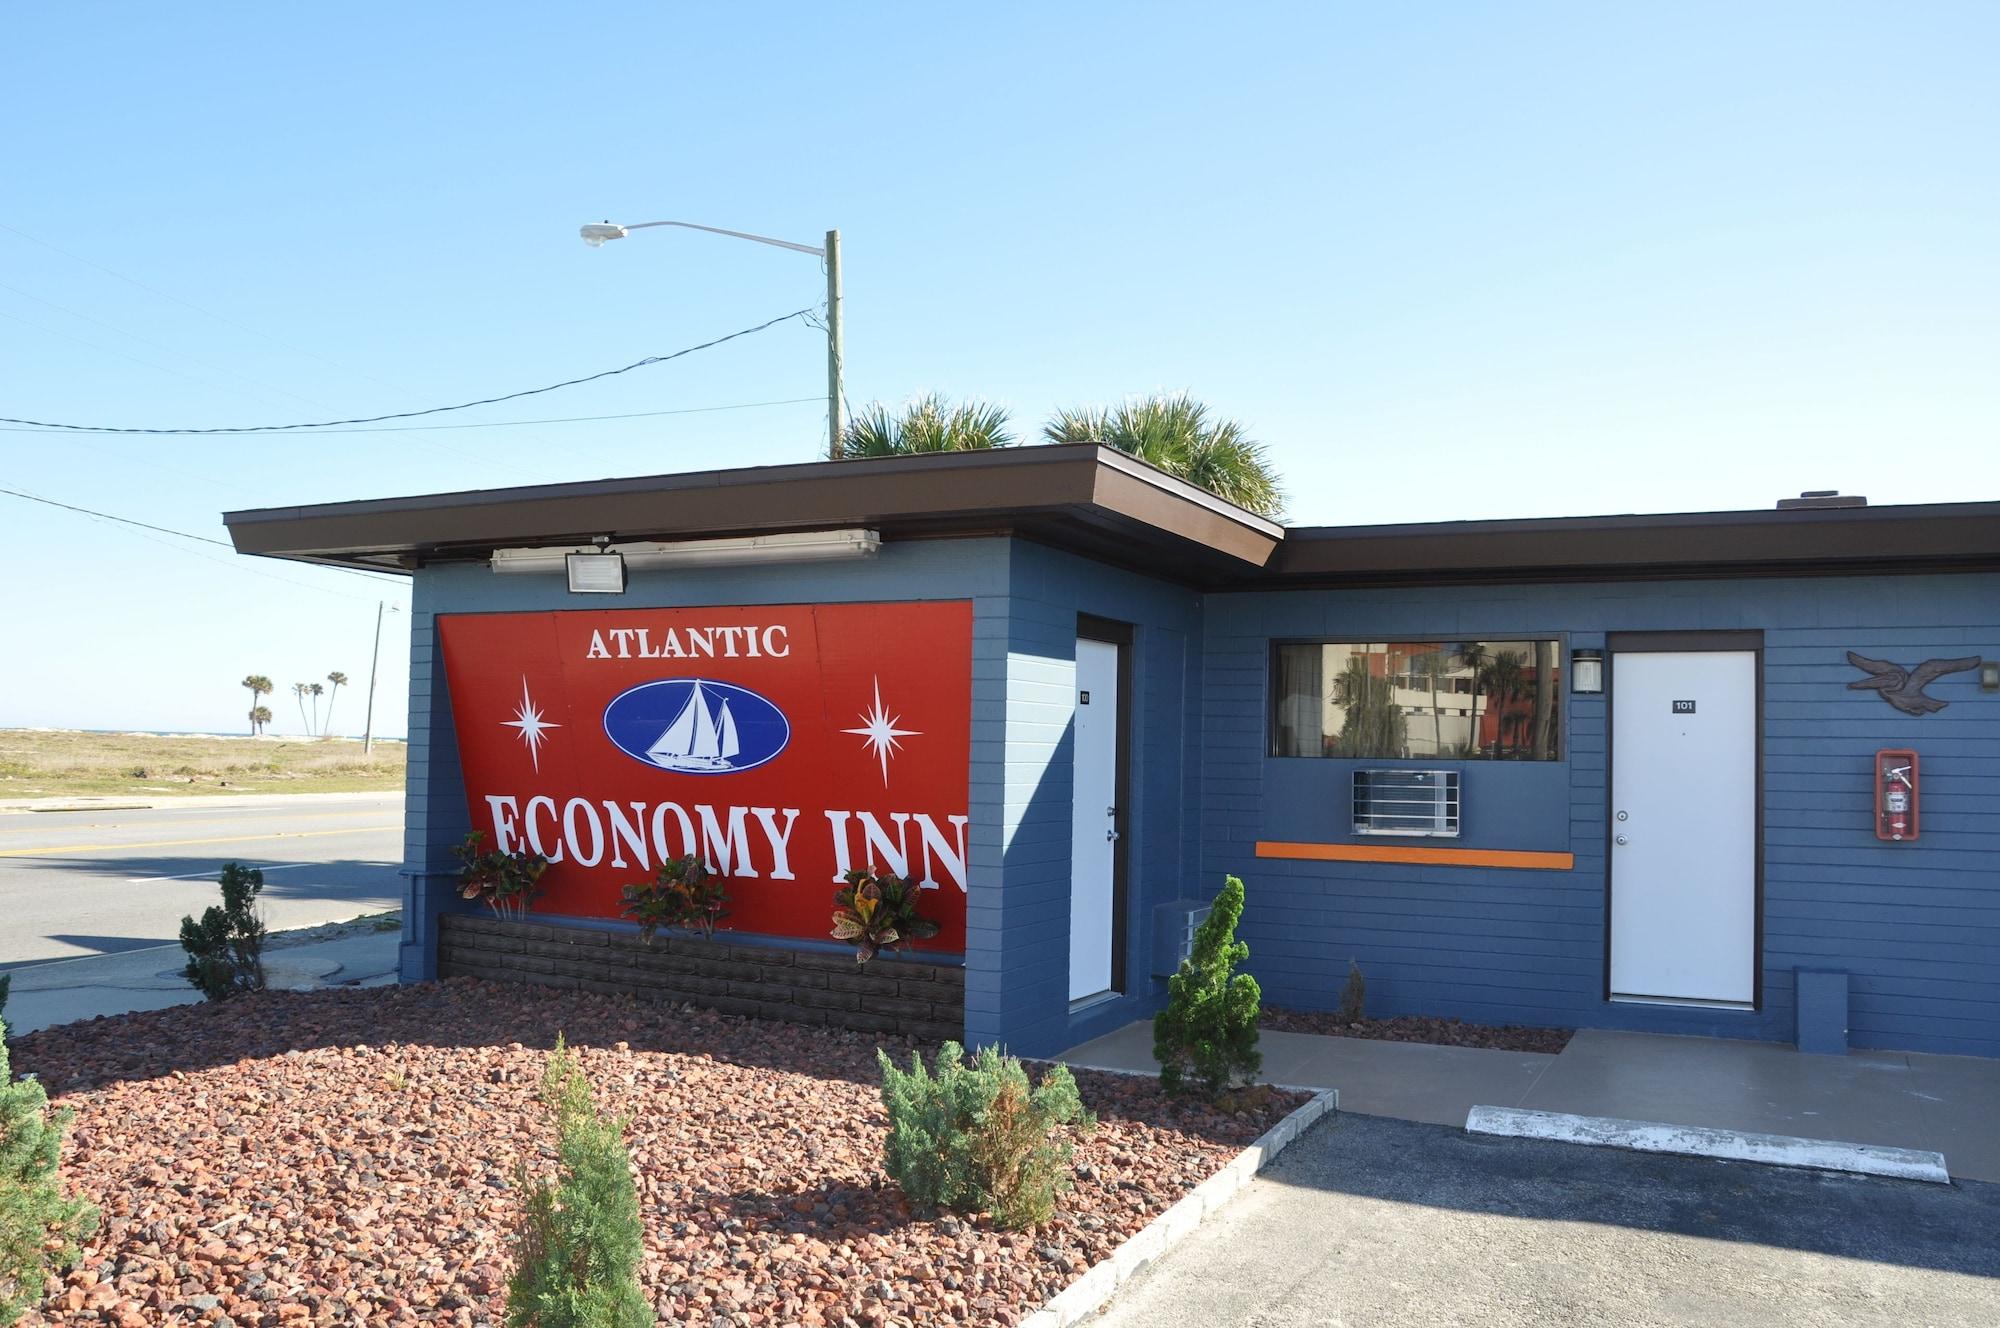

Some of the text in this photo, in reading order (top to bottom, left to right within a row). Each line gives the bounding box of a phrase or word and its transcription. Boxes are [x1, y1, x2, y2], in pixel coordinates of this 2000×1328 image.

[586, 625, 790, 658] ATLANTIC
[1675, 702, 1693, 710] 101
[484, 795, 968, 893] ECONOMY INN
